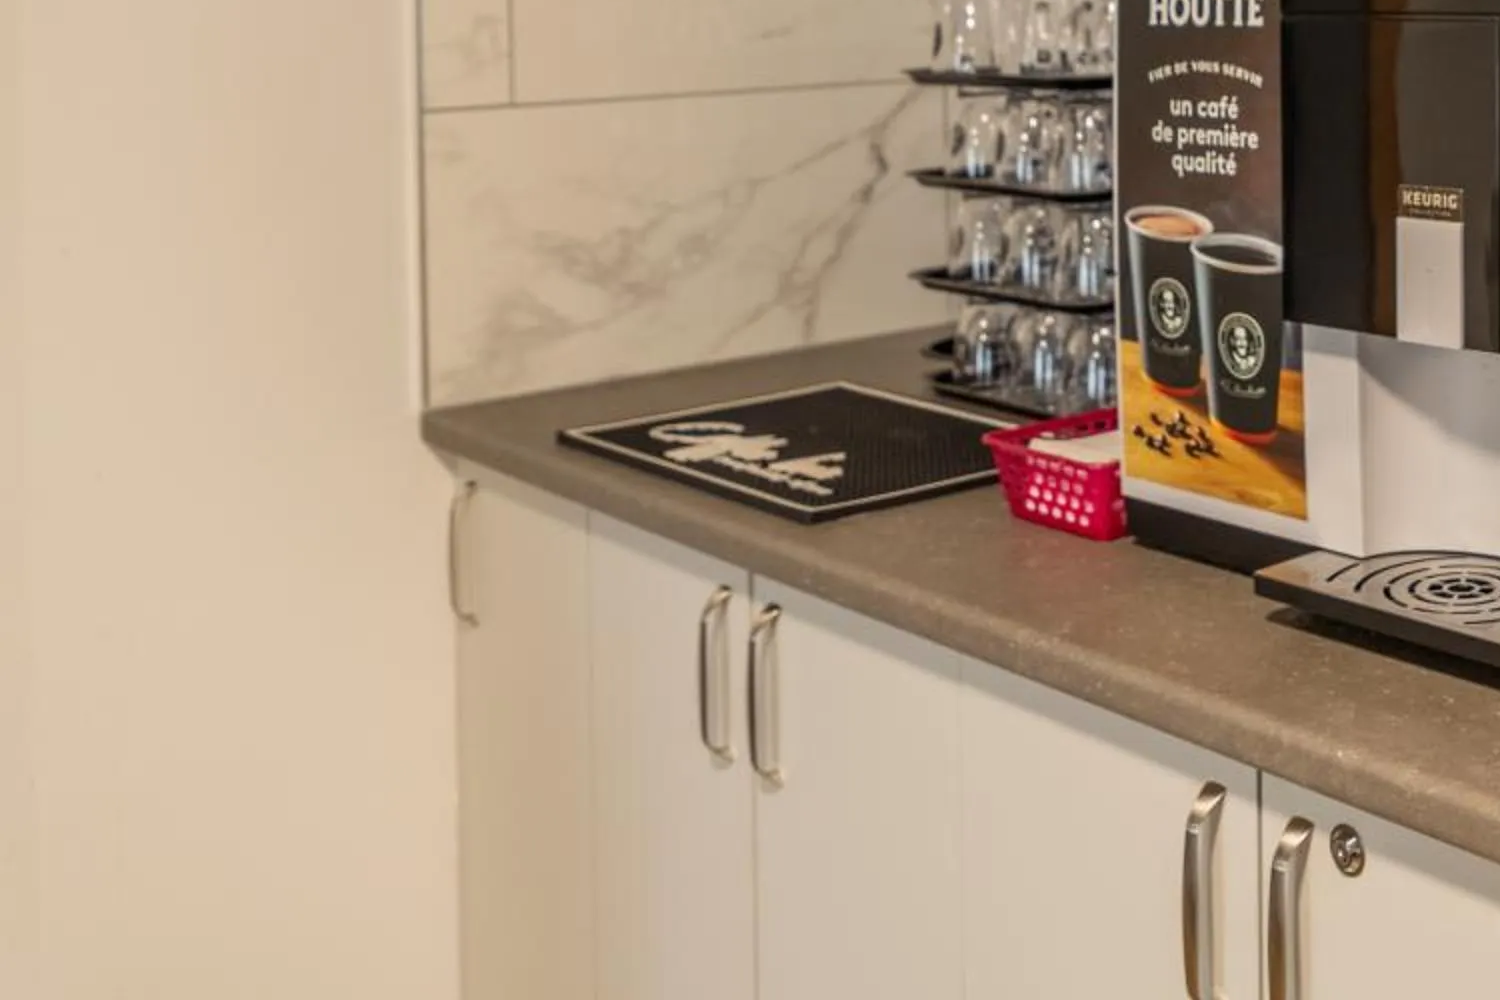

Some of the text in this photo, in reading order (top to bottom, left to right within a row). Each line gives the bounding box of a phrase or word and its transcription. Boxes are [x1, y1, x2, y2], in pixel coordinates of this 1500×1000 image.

[1191, 60, 1220, 74] VOUS
[1169, 96, 1240, 119] un café
[1152, 120, 1259, 150] de première
[1171, 152, 1237, 179] qualité
[1402, 190, 1458, 210] KEURIG
